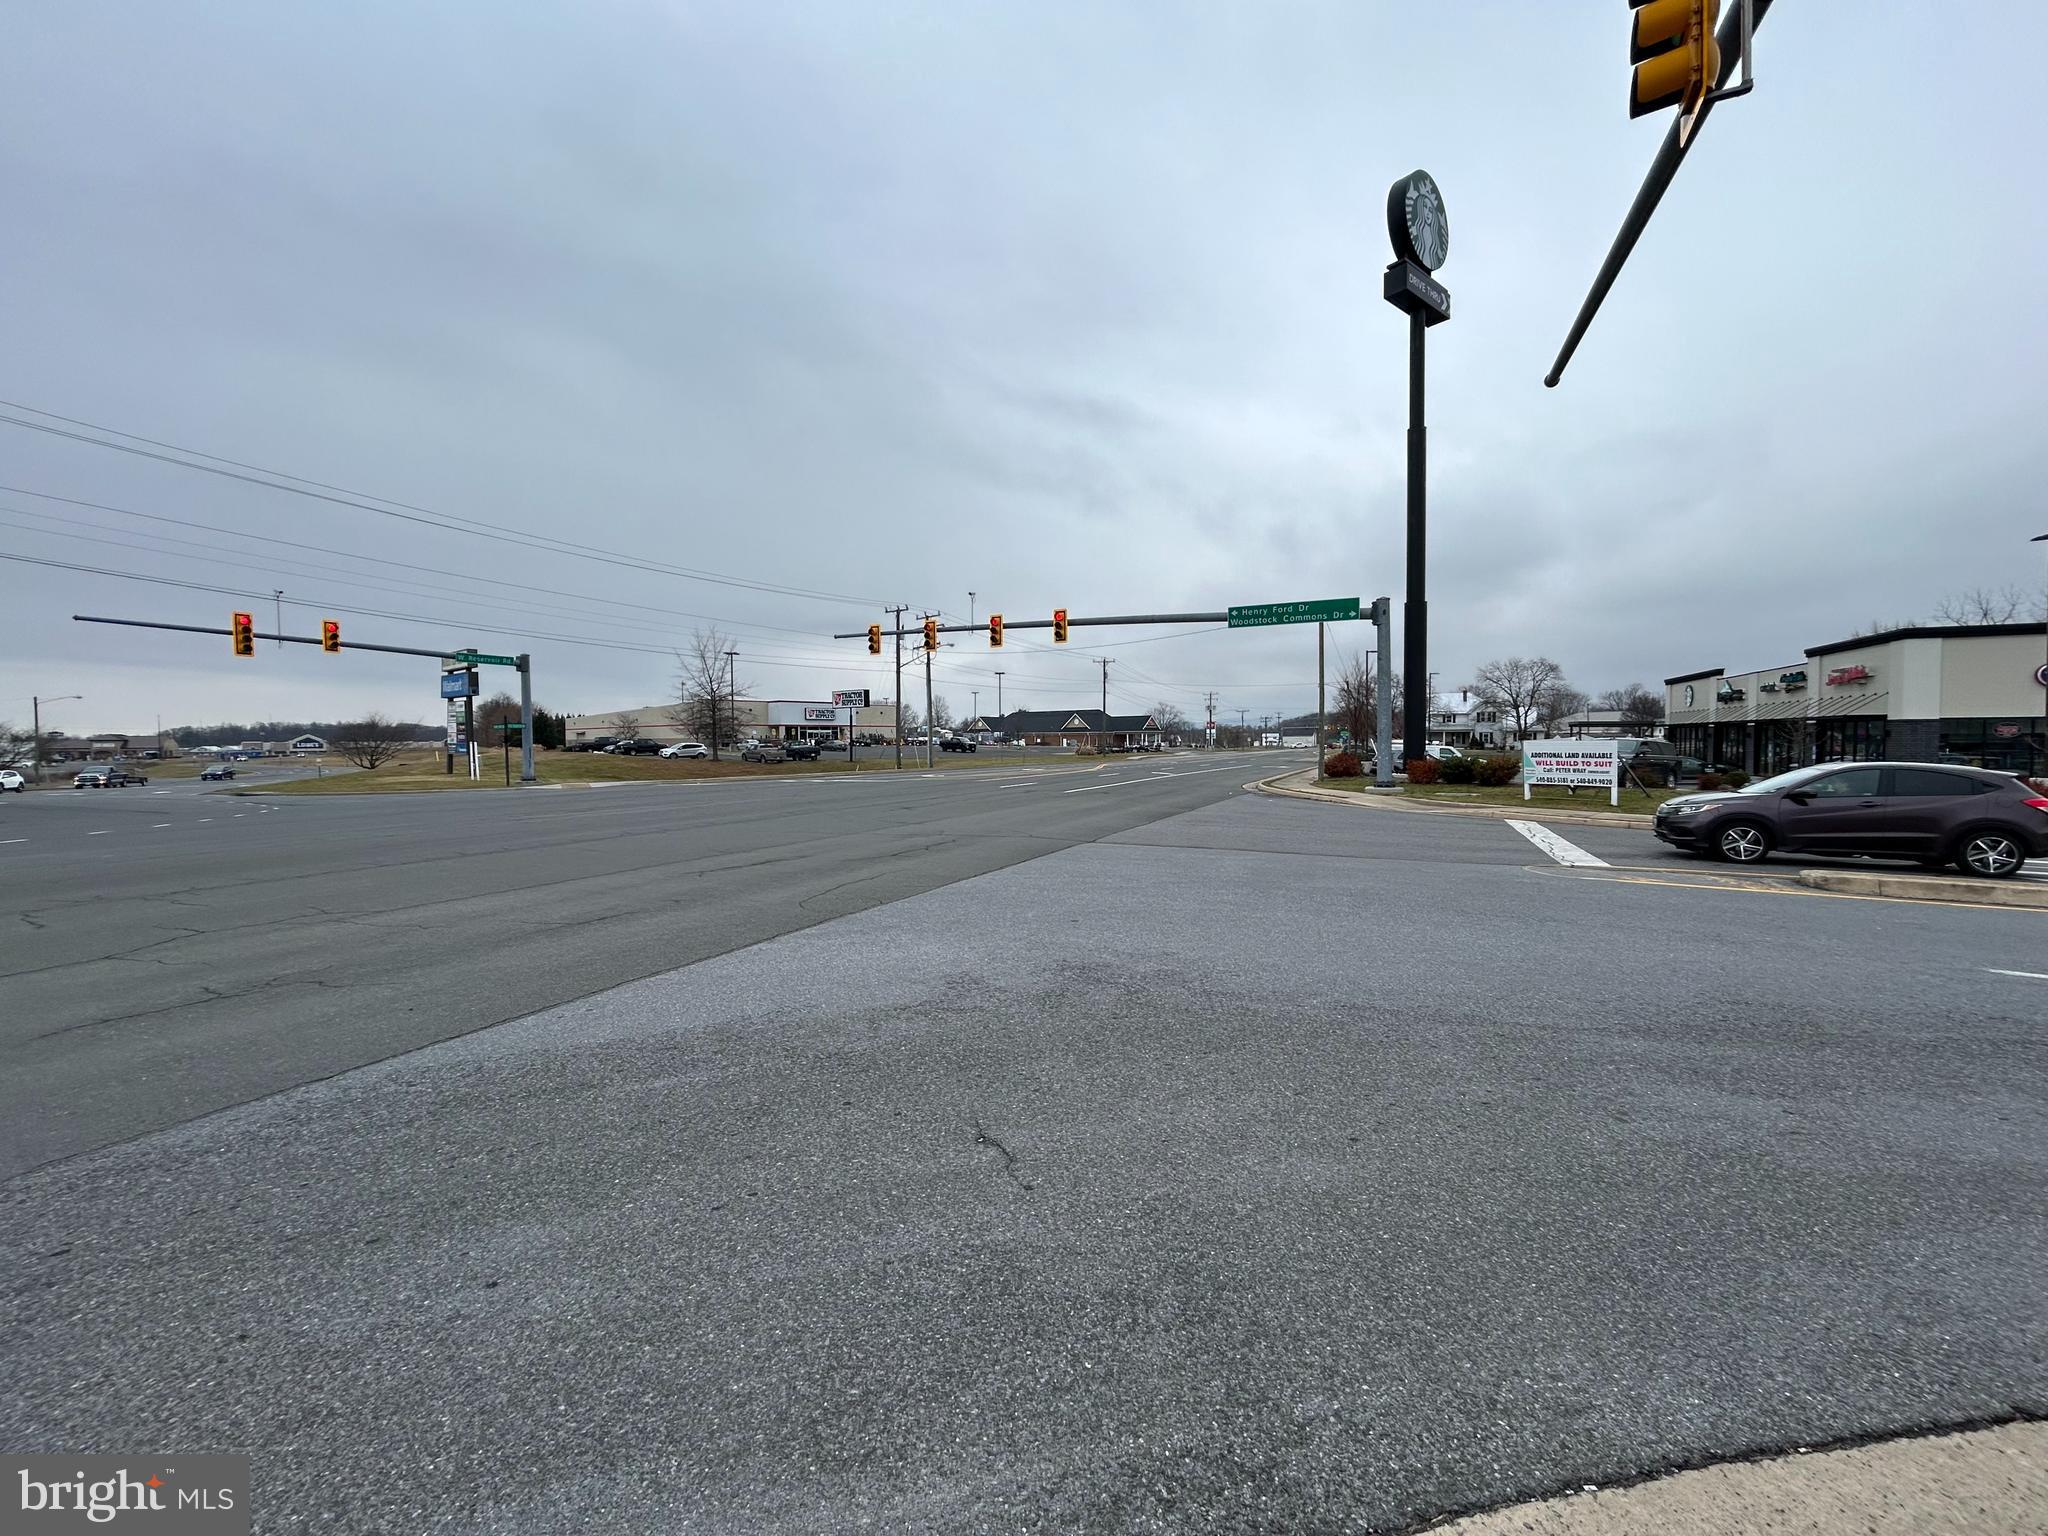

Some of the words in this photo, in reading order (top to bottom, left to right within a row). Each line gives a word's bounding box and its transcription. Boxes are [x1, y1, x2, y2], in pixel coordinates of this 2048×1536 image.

[1409, 273, 1426, 293] DRIVE
[1427, 286, 1441, 303] THRU
[1242, 607, 1268, 616] Henry
[1272, 605, 1293, 613] Ford
[1299, 604, 1309, 612] Dr
[1230, 615, 1278, 626] Woodstock
[1283, 612, 1328, 622] Commons
[1333, 610, 1344, 619] Dr
[468, 655, 500, 663] Reservoir
